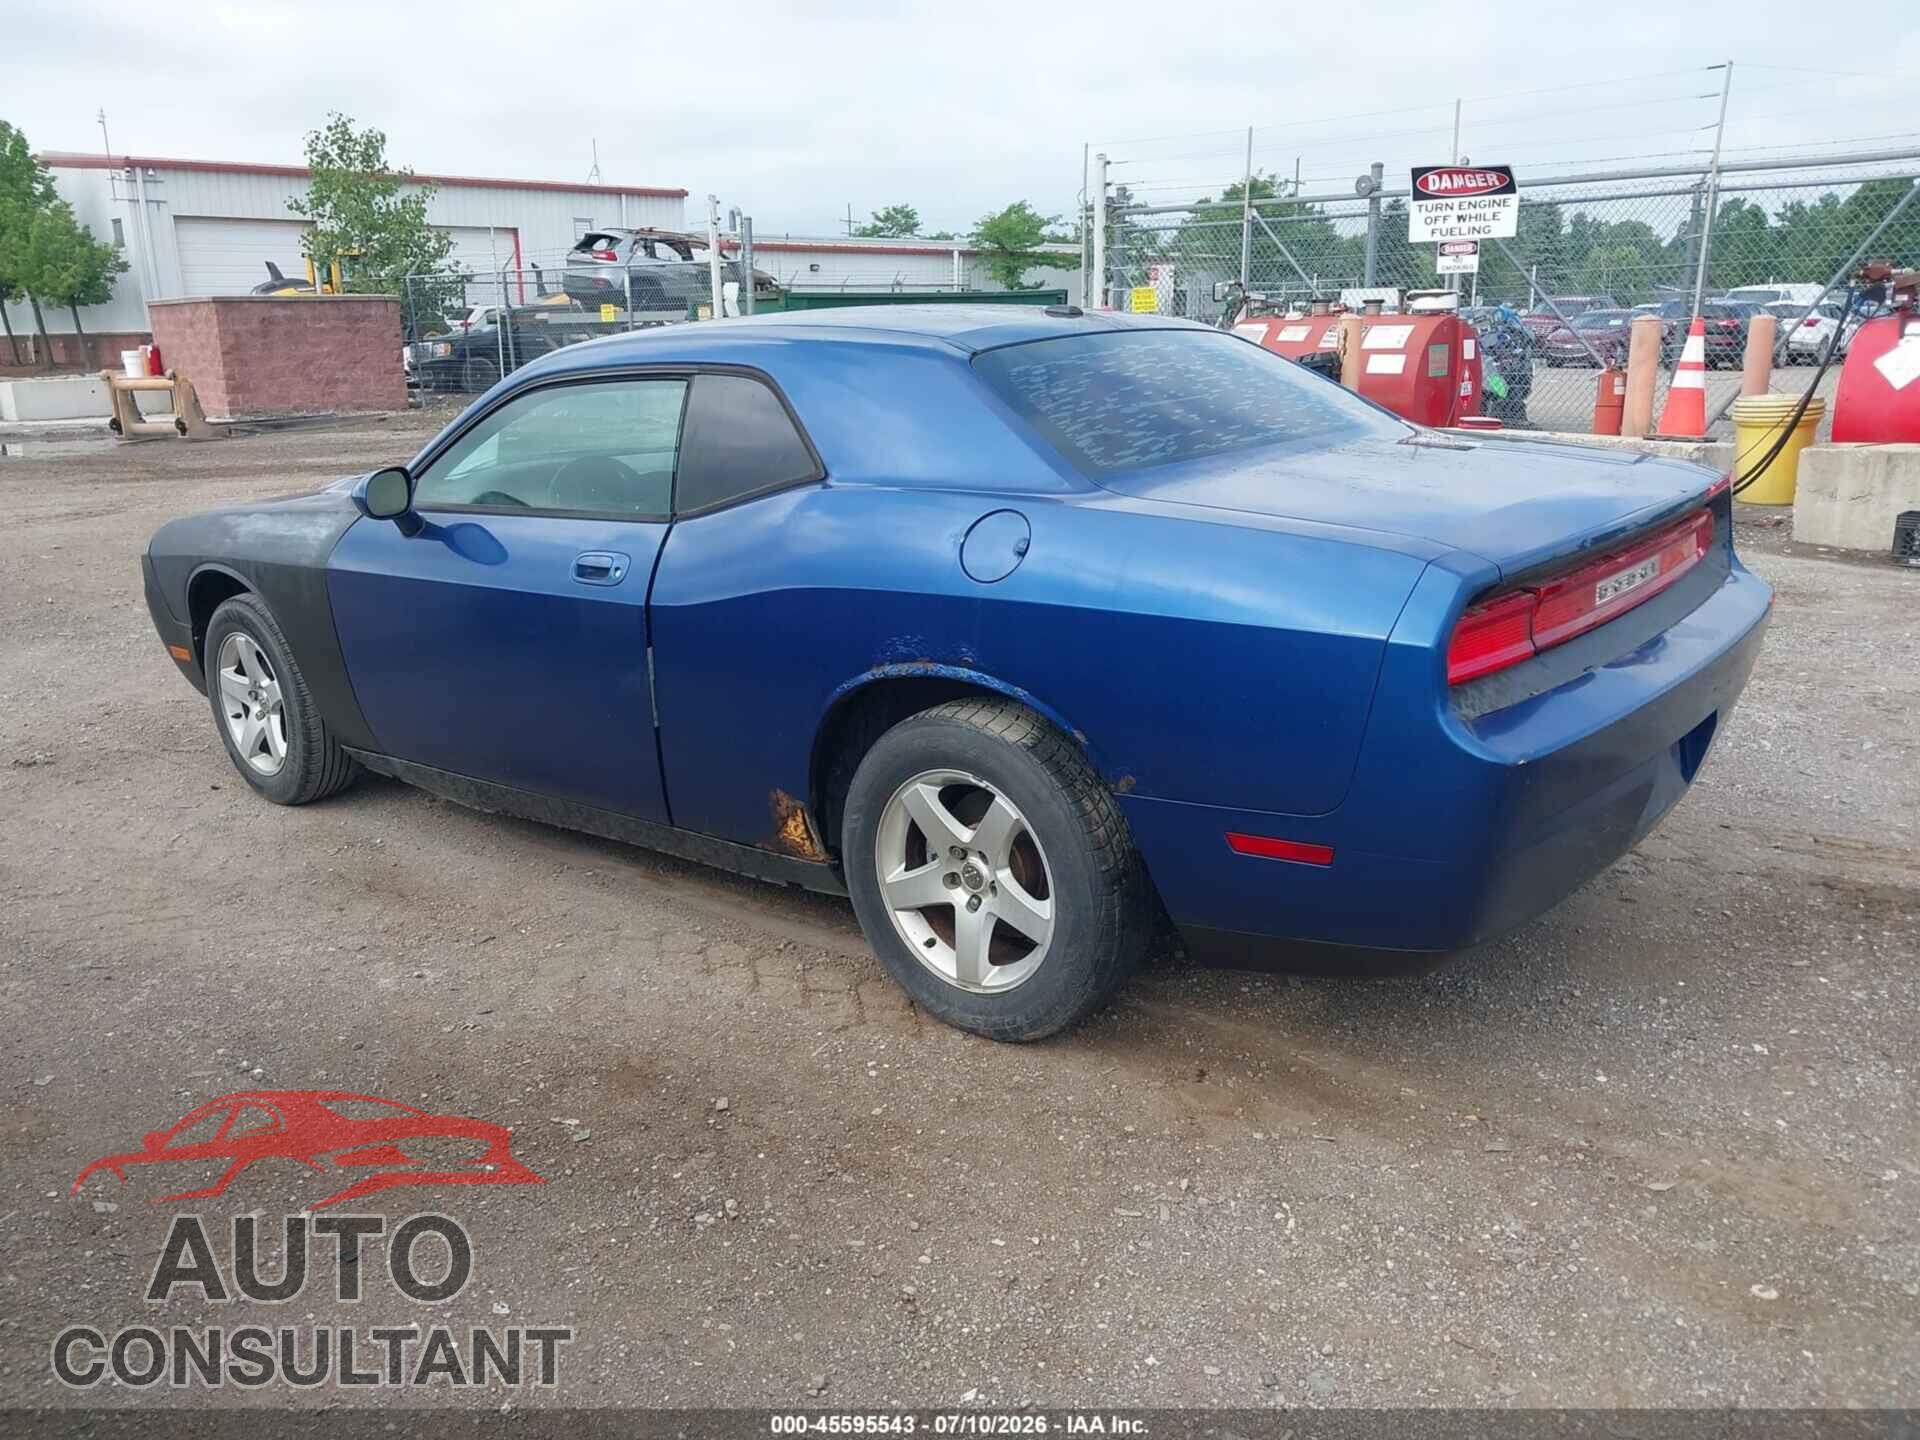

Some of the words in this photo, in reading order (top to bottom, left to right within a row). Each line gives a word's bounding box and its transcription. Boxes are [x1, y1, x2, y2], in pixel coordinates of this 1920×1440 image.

[1428, 174, 1499, 190] DANGER
[1417, 203, 1454, 213] TURN
[1458, 198, 1511, 210] ENGINE
[1424, 215, 1451, 226] OFF
[1457, 211, 1501, 223] WHILE
[1431, 225, 1492, 237] FUELING
[1444, 244, 1474, 252] DANGER
